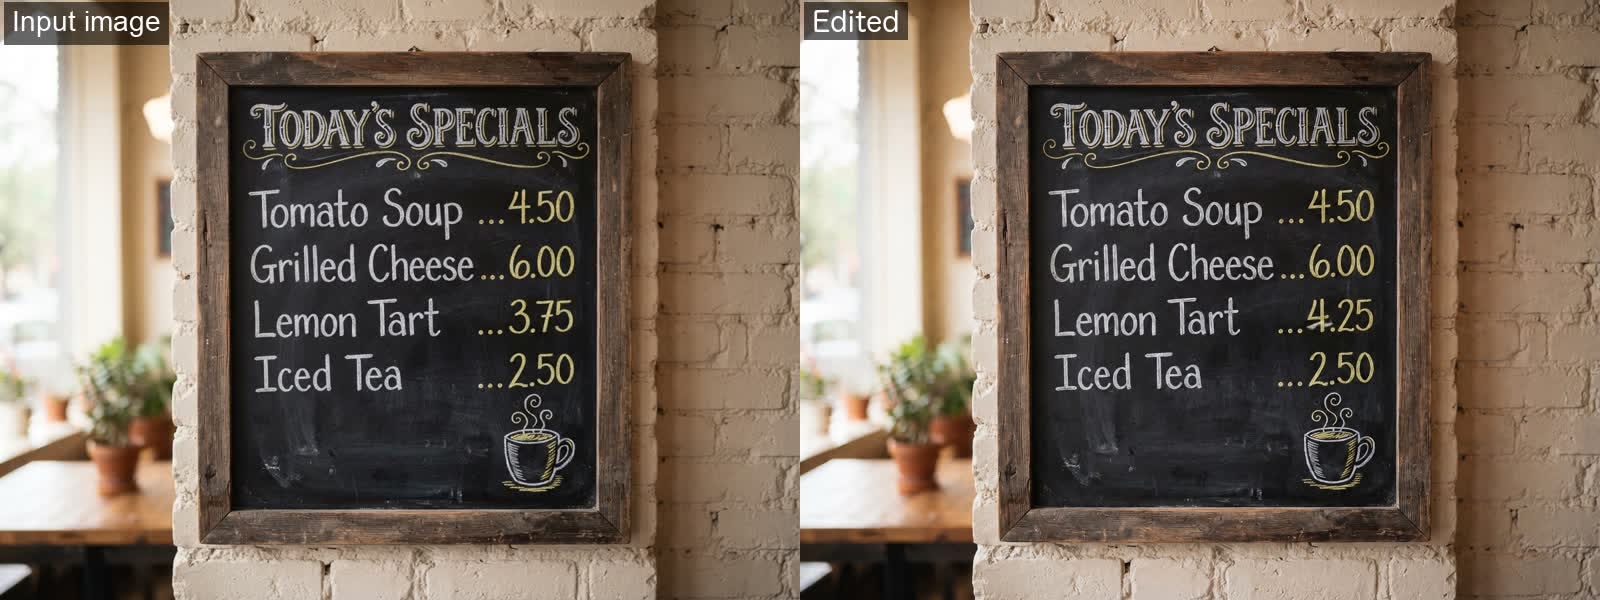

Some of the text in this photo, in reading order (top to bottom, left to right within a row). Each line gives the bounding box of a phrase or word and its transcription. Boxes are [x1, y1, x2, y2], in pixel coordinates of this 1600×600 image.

[250, 101, 580, 149] TODAY'S SPECIALS
[1050, 101, 1380, 149] TODAY'S SPECIALS
[249, 189, 368, 228] Tomato
[383, 188, 462, 240] Soup
[1049, 189, 1168, 227] Tomato
[1183, 187, 1262, 239] Soup
[251, 244, 356, 284] Grilled
[369, 244, 473, 282] Cheese
[1051, 244, 1156, 283] Grilled
[1169, 244, 1273, 281] Cheese
[255, 300, 356, 338] Lemon
[368, 298, 440, 336] Tart
[1054, 299, 1156, 336] Lemon
[1168, 297, 1240, 335] Tart
[255, 354, 331, 392] Iced
[345, 354, 402, 391] Tea
[1055, 352, 1131, 391] Iced
[1145, 352, 1202, 389] Tea
